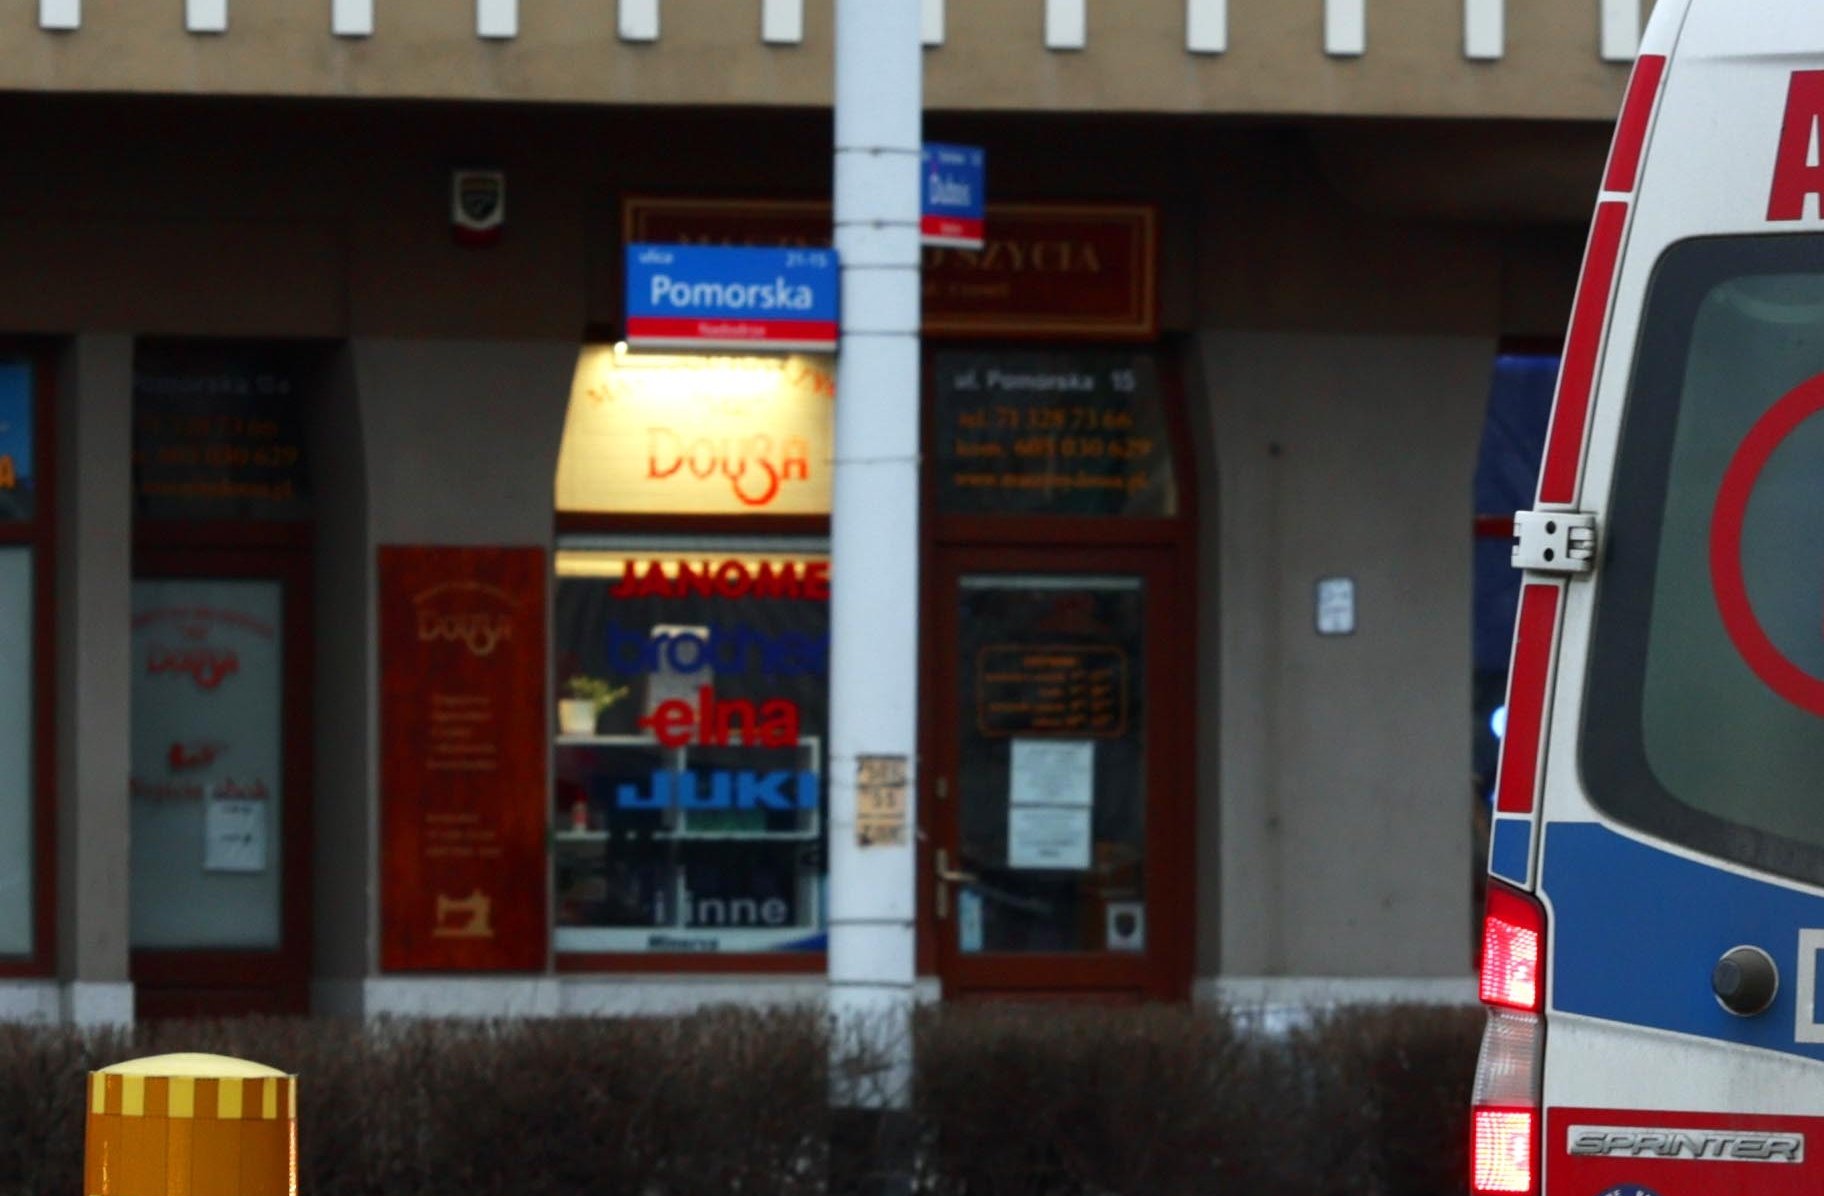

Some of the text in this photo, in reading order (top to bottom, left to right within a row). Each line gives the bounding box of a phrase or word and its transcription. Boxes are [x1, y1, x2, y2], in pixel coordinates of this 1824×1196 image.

[652, 274, 813, 309] Pomorska
[610, 558, 830, 599] JANOME
[617, 770, 819, 810] JUKI
[1571, 1131, 1801, 1162] SPRINTER
